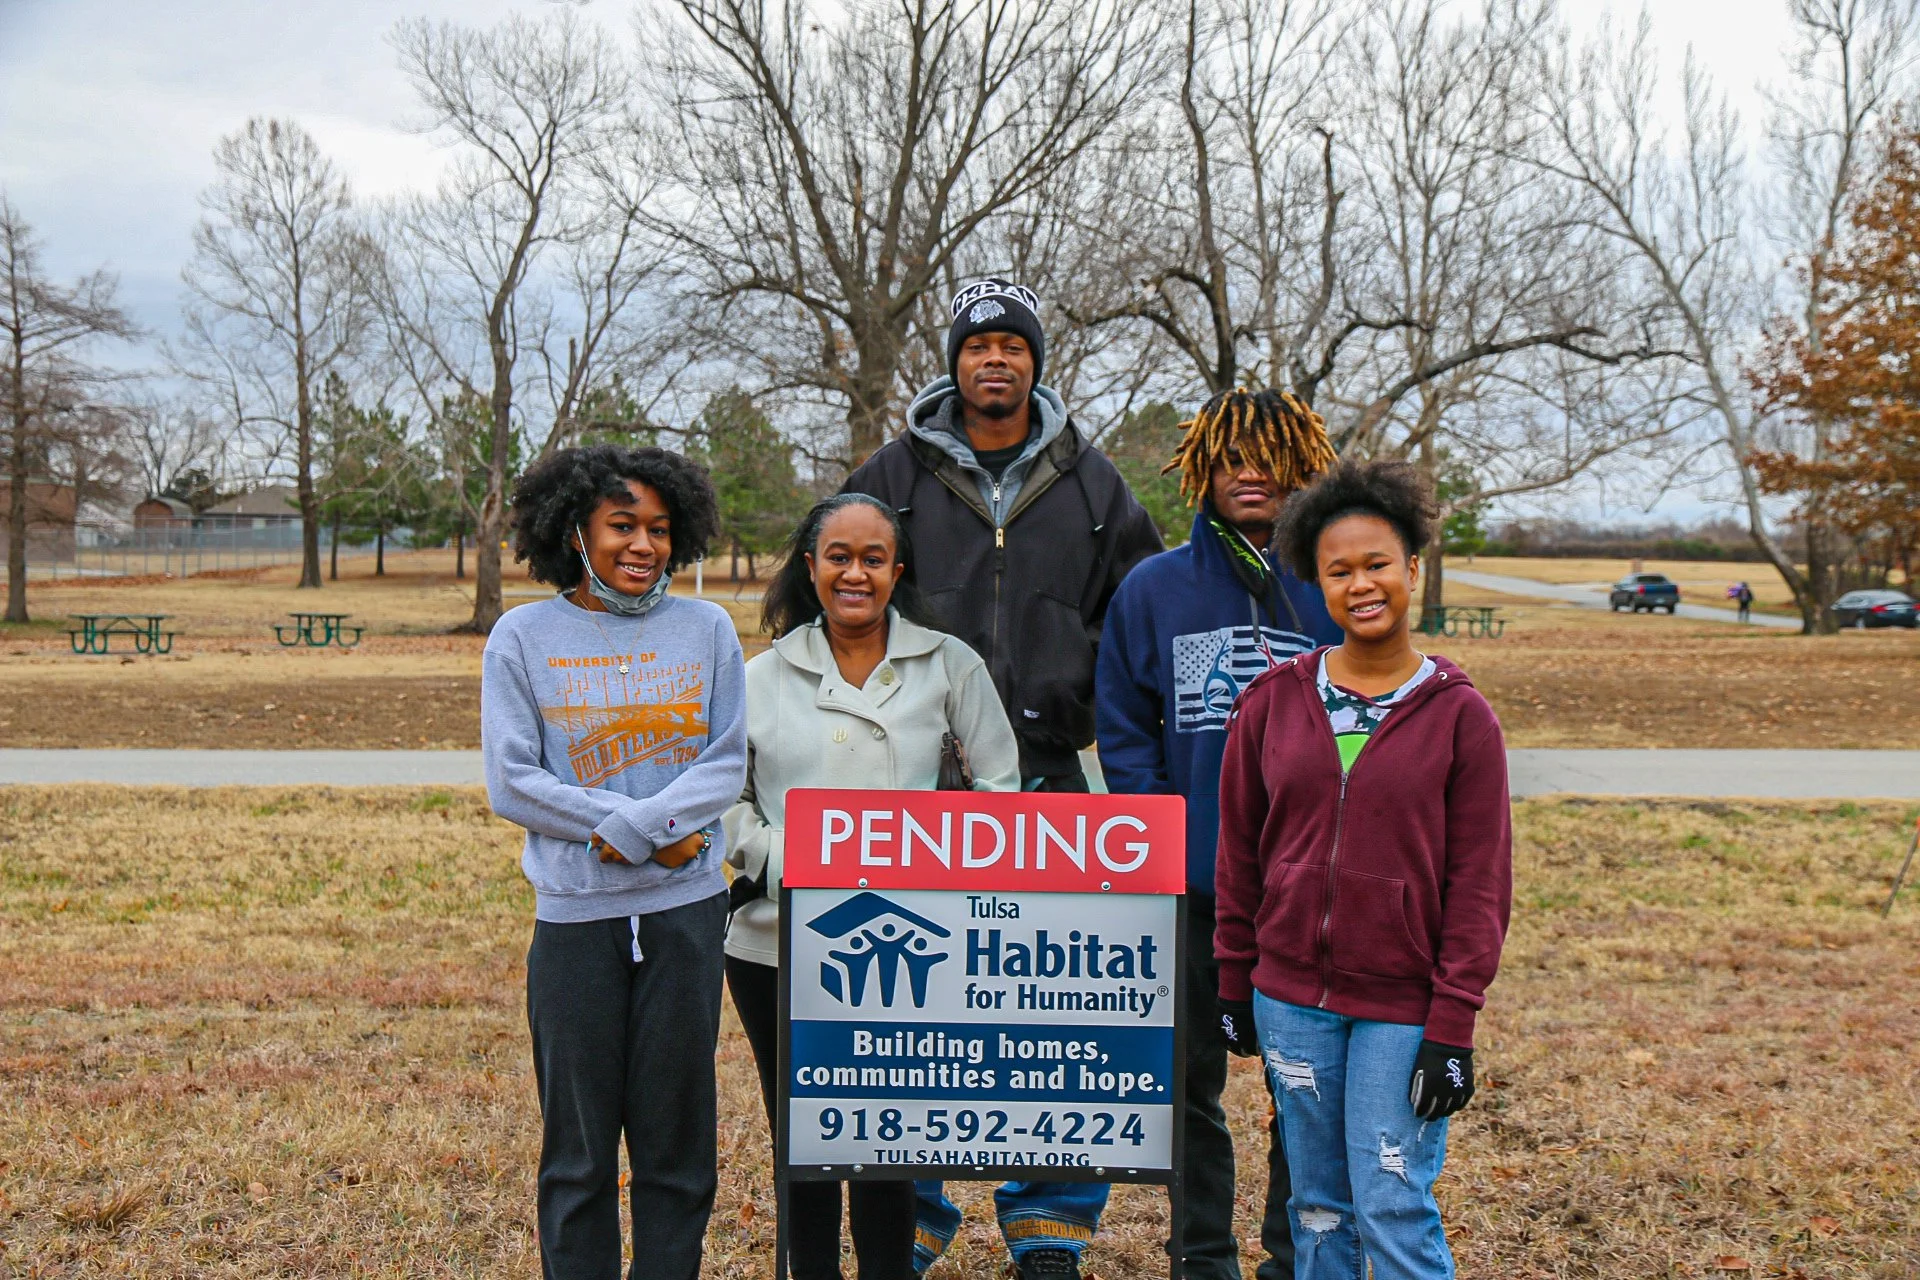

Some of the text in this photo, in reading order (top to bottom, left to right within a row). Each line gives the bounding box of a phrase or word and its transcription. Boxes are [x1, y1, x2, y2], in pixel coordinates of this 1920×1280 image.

[547, 652, 657, 668] UNIVERSITY OF
[820, 807, 1150, 873] PENDING
[966, 895, 1020, 920] Tulsa
[965, 928, 1158, 980] Habitat
[965, 983, 1006, 1009] for
[853, 1030, 1109, 1064] Building homes,
[796, 1062, 1165, 1097] communities and hope.
[818, 1106, 1146, 1147] 918-592-4224
[874, 1149, 1090, 1167] TULSAHABITAT.ORG
